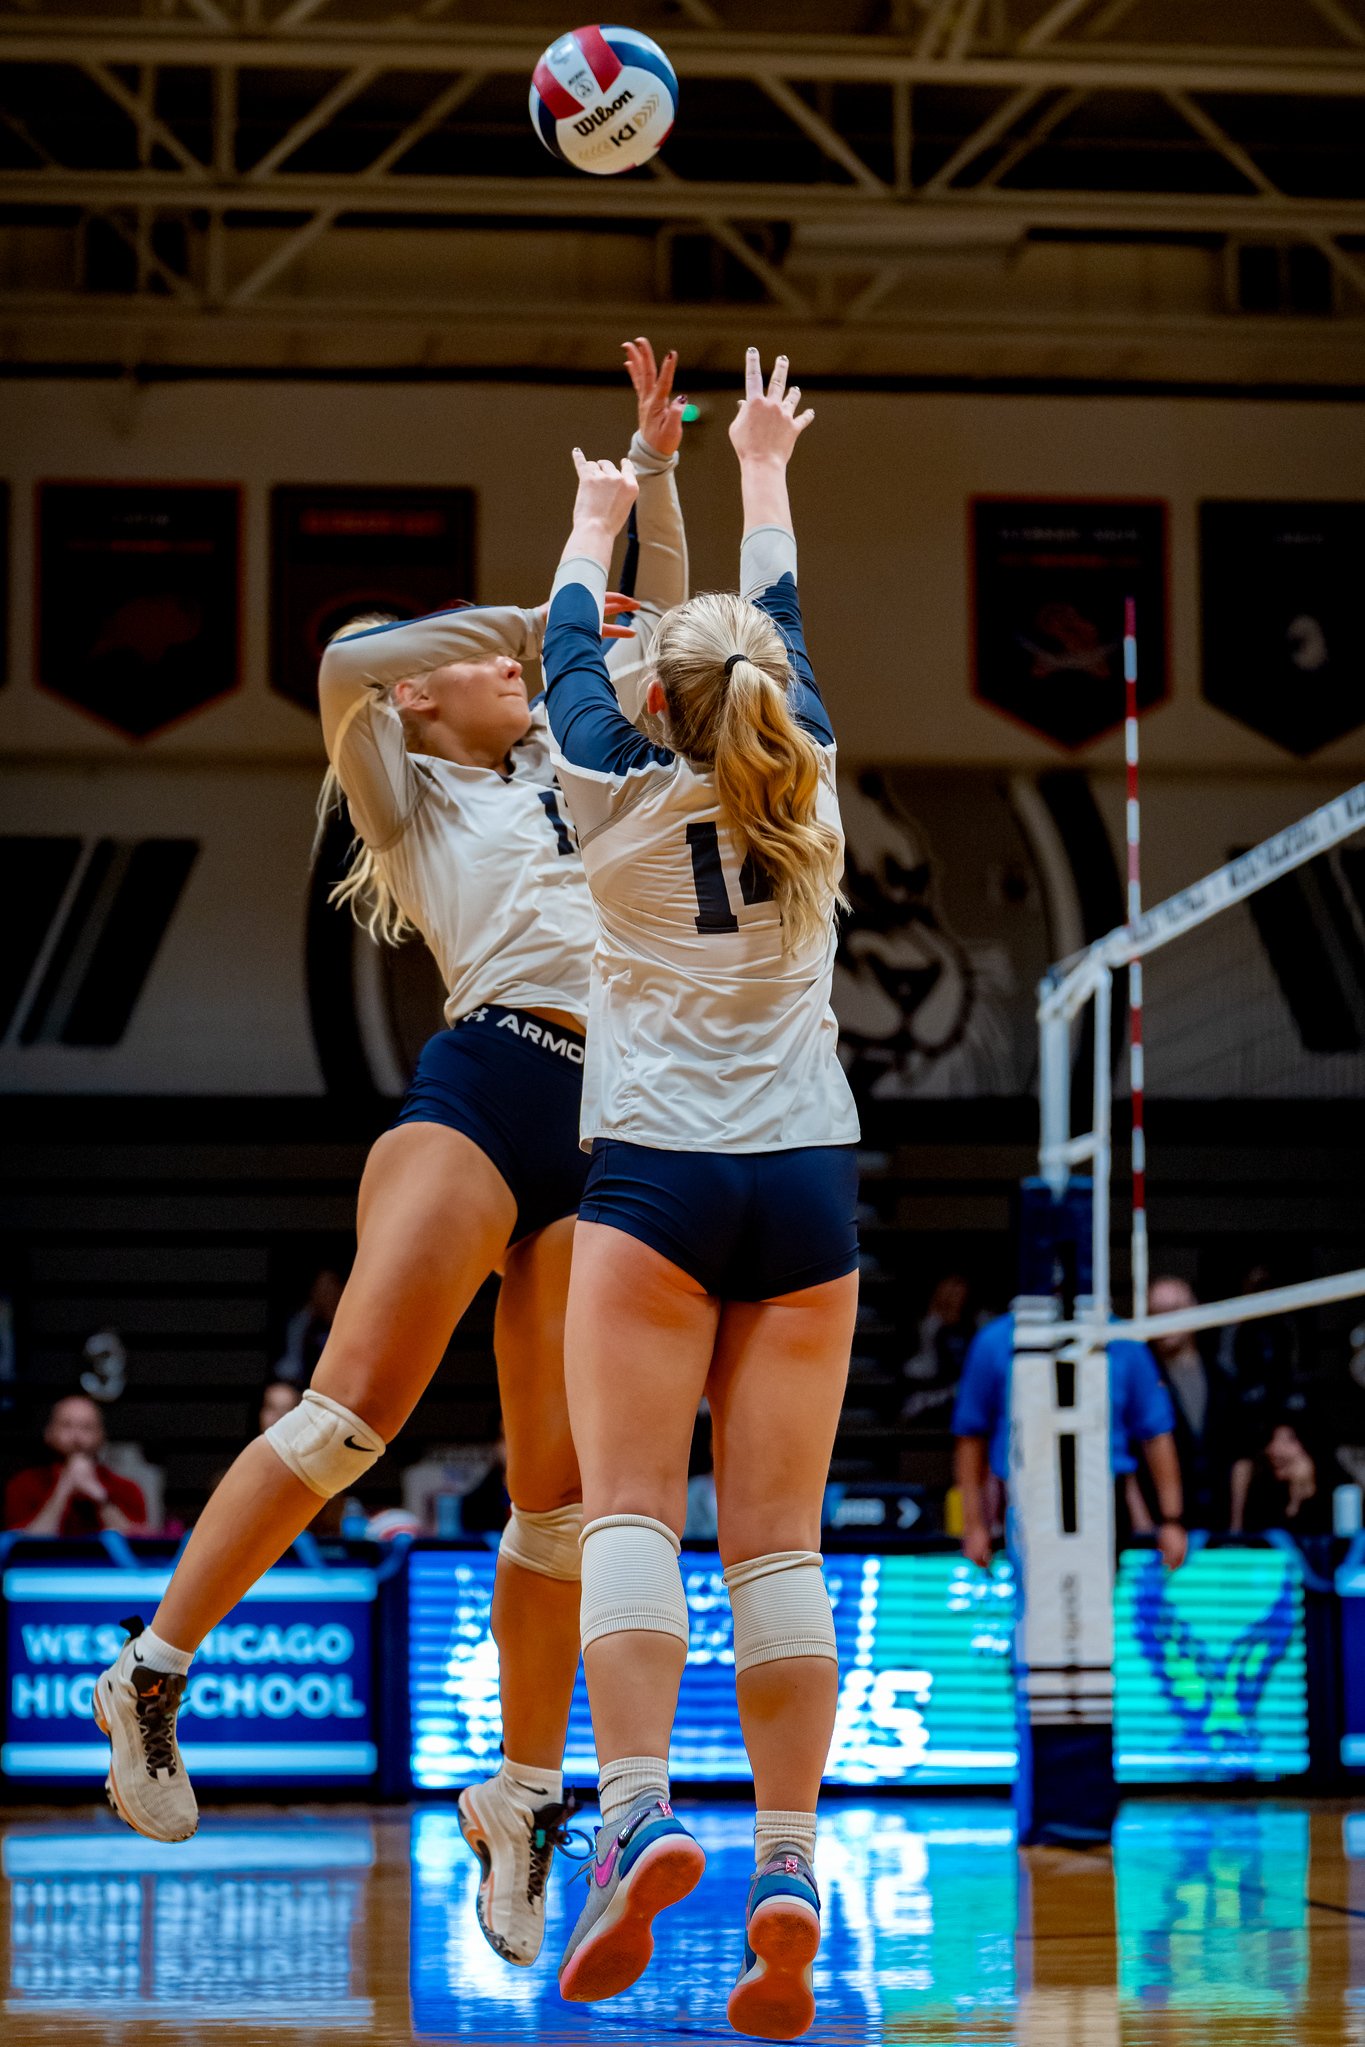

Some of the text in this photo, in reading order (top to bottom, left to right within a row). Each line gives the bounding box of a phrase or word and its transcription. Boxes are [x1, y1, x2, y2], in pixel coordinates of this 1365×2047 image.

[573, 90, 634, 137] Wilson
[537, 790, 580, 856] 1
[496, 1013, 585, 1065] ARMO
[21, 1623, 130, 1665] WES
[178, 1671, 366, 1719] CHOOL
